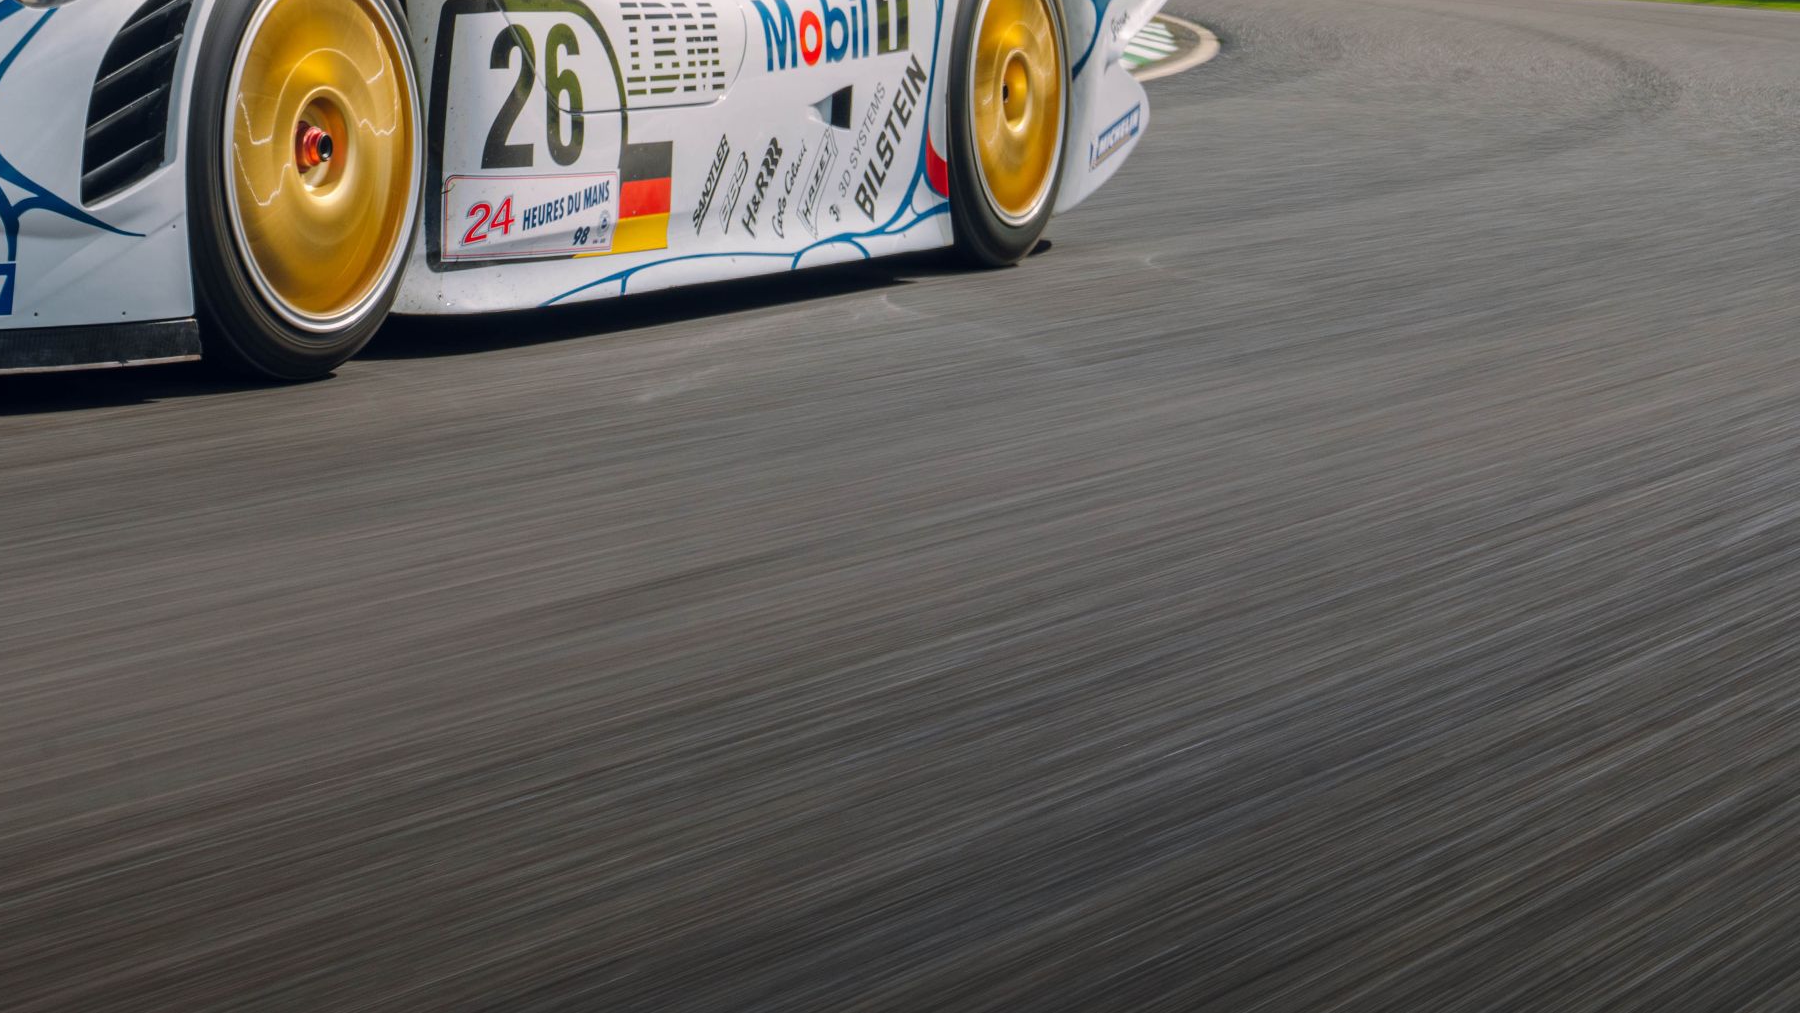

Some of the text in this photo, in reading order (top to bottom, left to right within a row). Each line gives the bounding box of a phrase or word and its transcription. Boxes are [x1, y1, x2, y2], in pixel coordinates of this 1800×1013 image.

[480, 22, 585, 169] 26
[619, 1, 725, 96] IBM
[693, 133, 728, 229] SANDTLER
[802, 140, 831, 230] HAZET
[838, 81, 886, 198] 3D SYSTEMS
[854, 52, 928, 223] BILSTEIN
[461, 194, 516, 246] 24
[522, 197, 565, 231] HEURES
[567, 193, 581, 215] DU
[583, 179, 611, 211] MANS
[572, 226, 591, 246] 98
